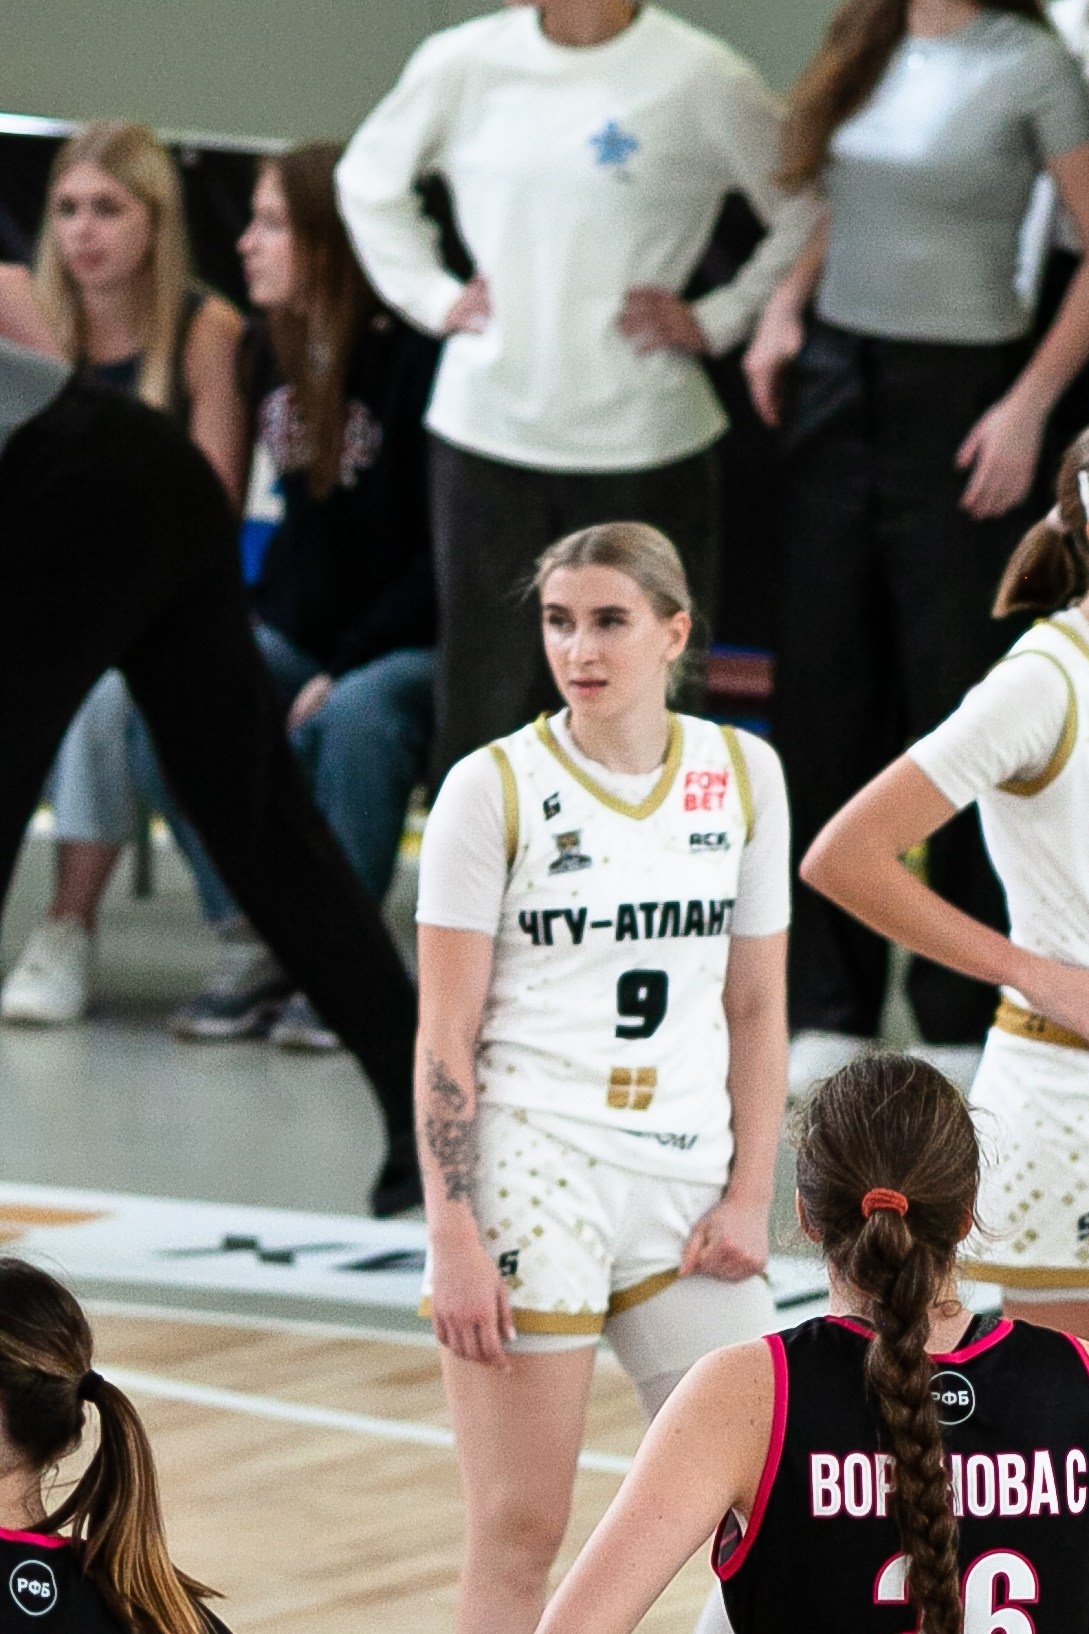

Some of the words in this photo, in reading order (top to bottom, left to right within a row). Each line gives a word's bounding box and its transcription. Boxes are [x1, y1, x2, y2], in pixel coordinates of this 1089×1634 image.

[615, 968, 668, 1039] 9
[1066, 1448, 1088, 1515] С
[17, 1577, 51, 1598] РФБ
